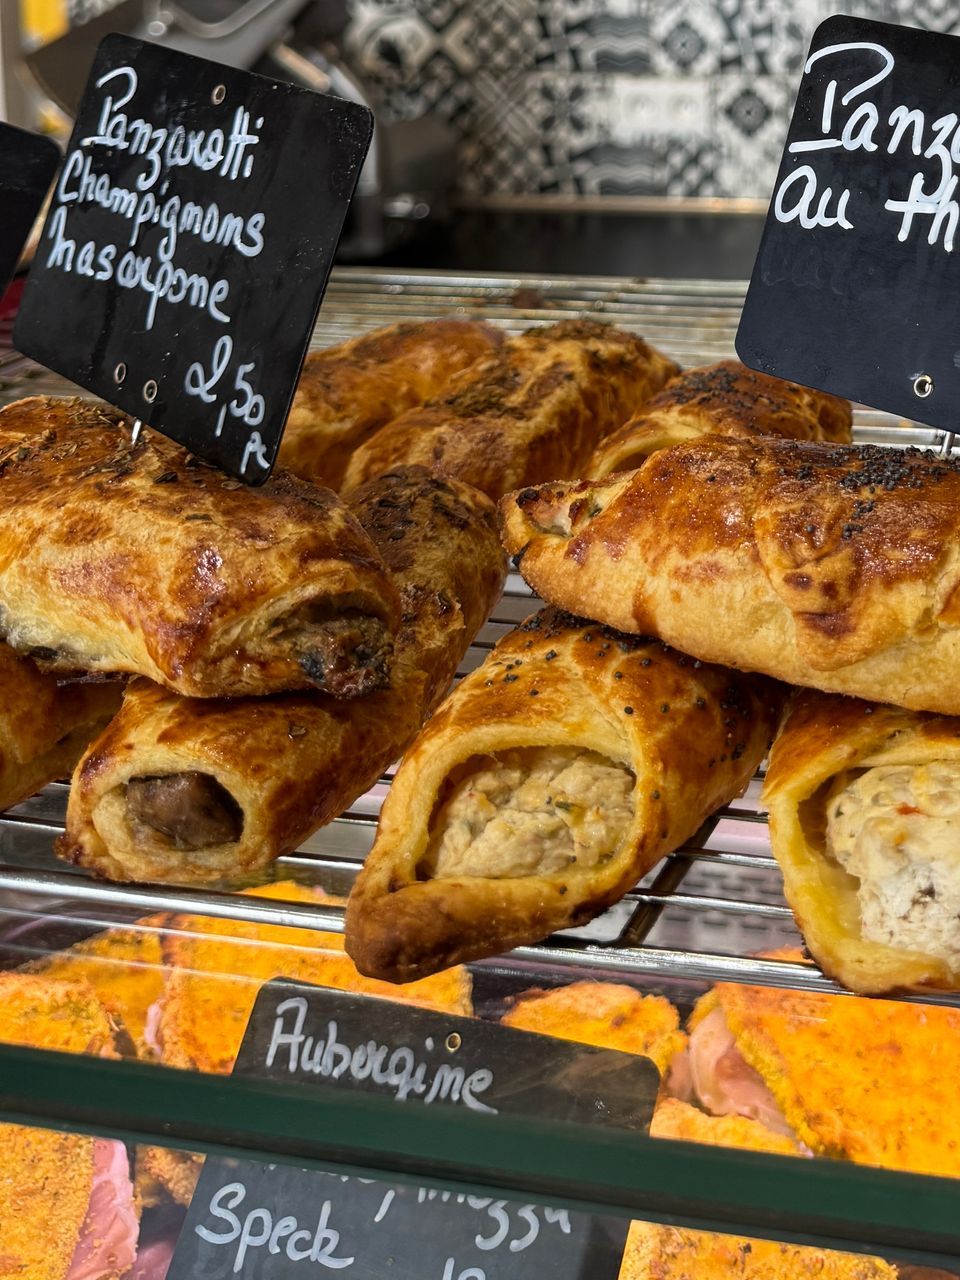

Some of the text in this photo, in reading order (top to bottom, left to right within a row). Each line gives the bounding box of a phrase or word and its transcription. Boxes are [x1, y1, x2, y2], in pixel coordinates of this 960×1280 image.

[82, 65, 265, 189] Panzarotti
[58, 149, 266, 263] Champignons
[184, 334, 266, 438] 2,50
[264, 995, 499, 1116] Aubergine
[194, 1181, 356, 1273] Speck
